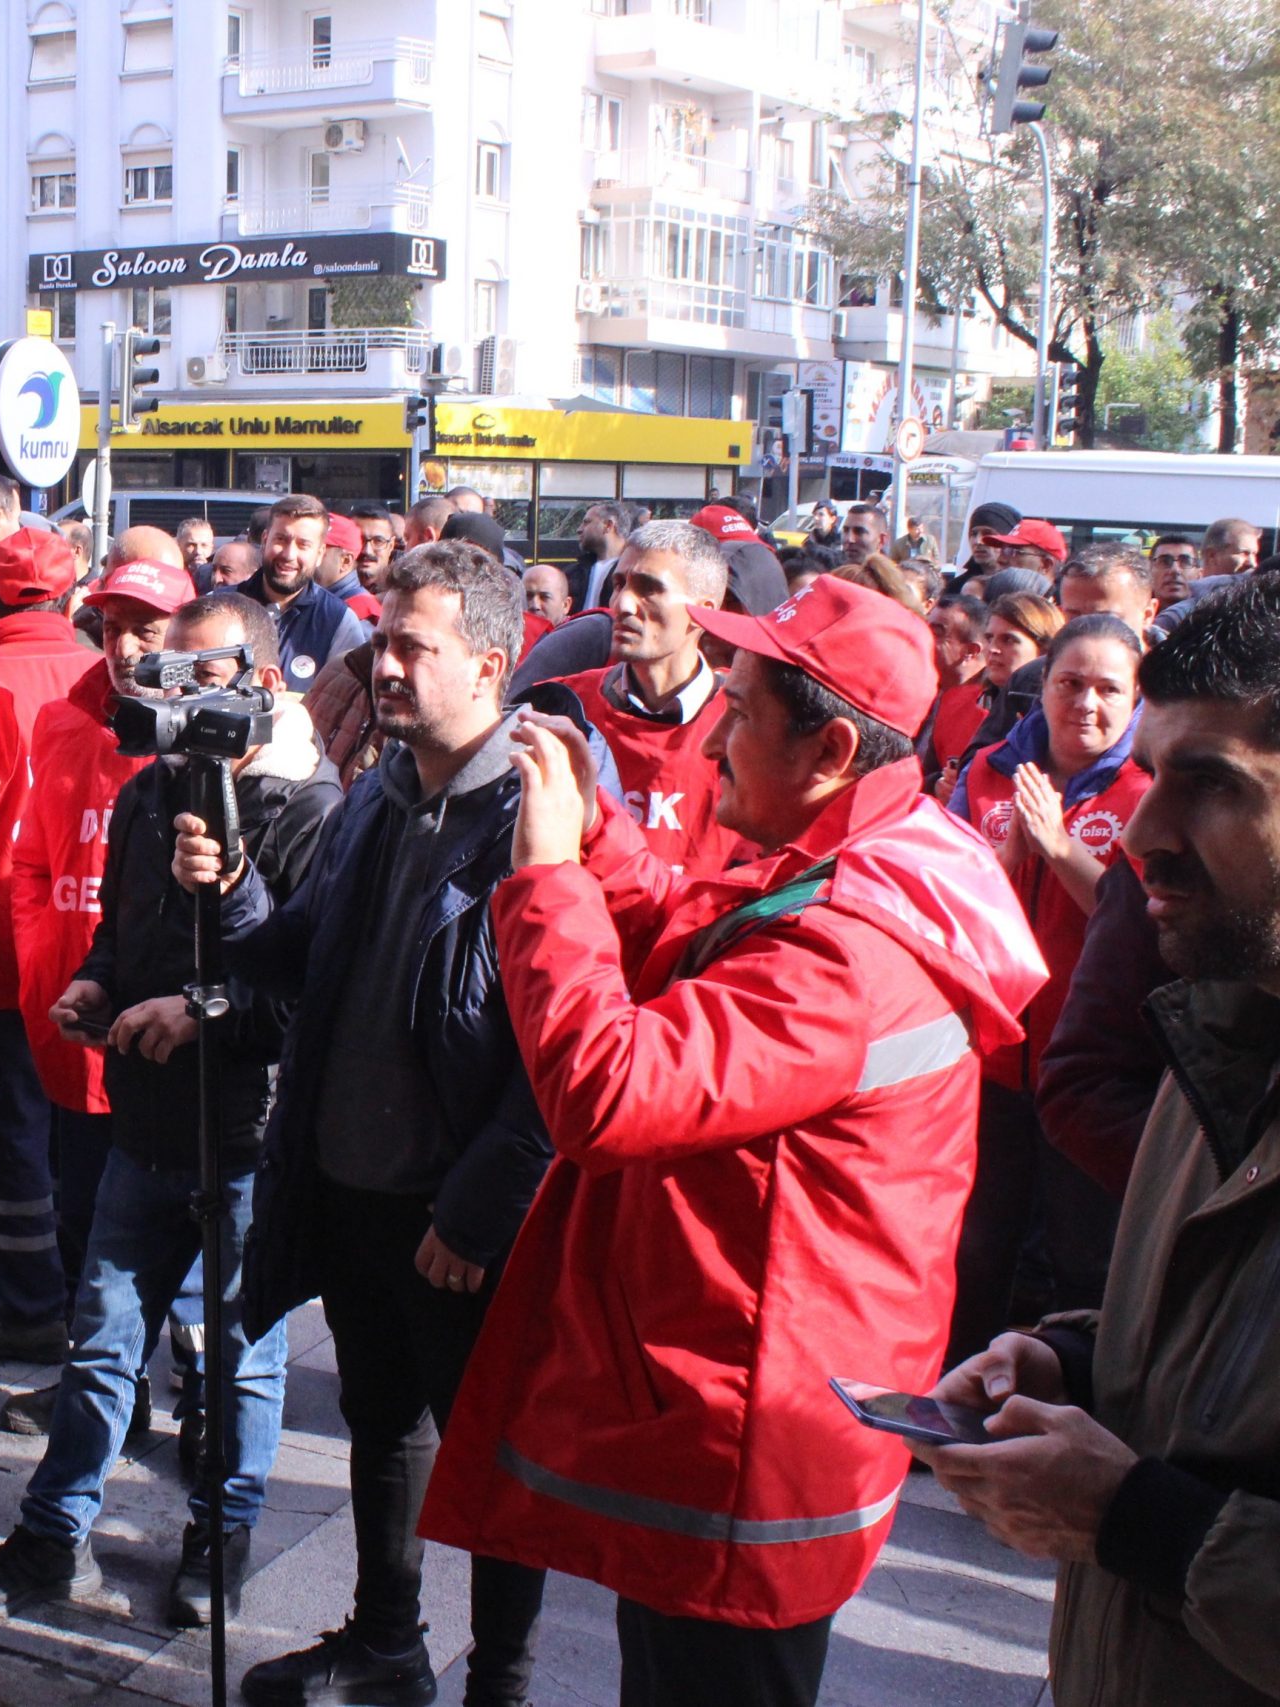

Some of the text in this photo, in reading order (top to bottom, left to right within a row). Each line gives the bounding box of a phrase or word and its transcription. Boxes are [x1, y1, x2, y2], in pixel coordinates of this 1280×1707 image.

[92, 242, 308, 287] Saloon Damla
[142, 415, 363, 436] Alsancak Unlu Mamuller
[19, 435, 69, 460] kumru
[1080, 825, 1112, 838] DİSK
